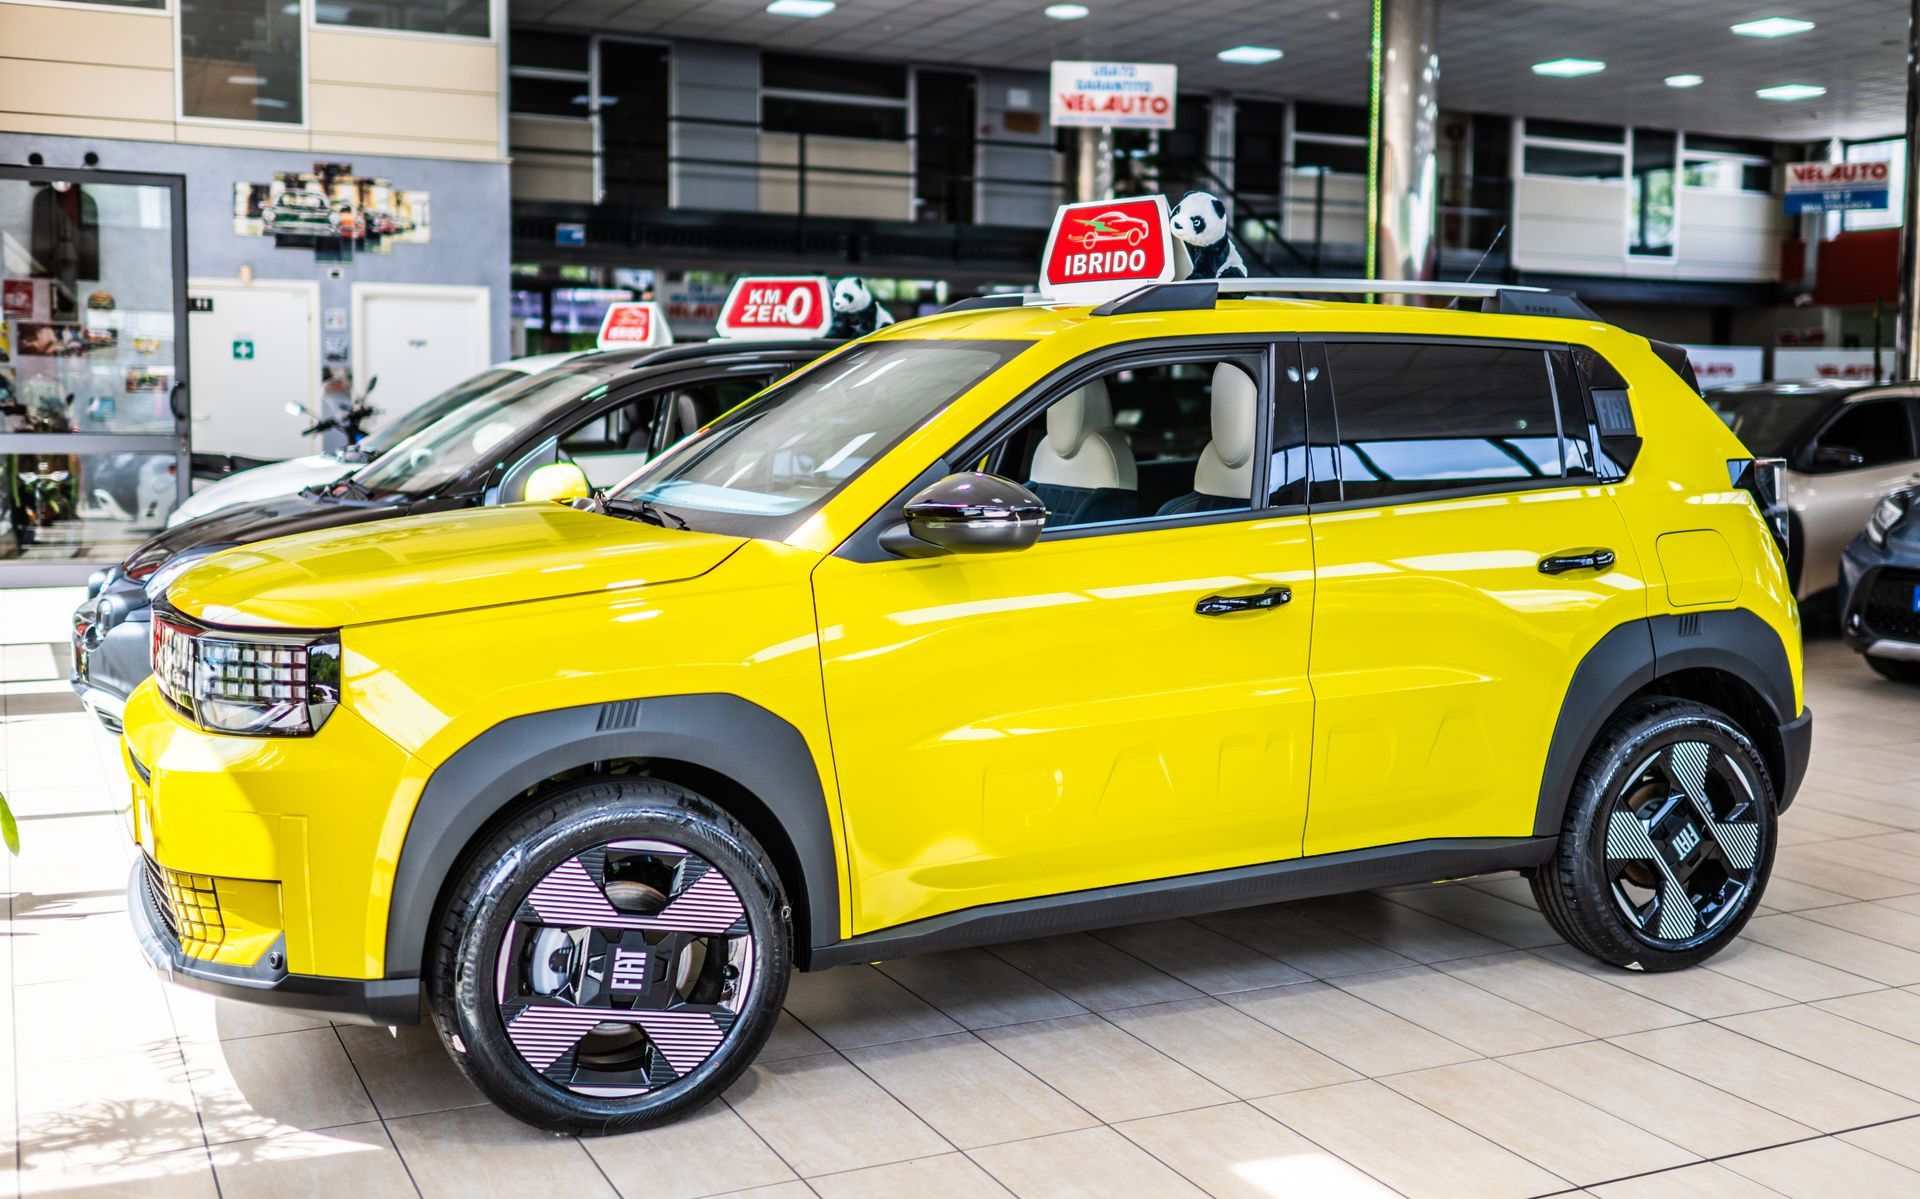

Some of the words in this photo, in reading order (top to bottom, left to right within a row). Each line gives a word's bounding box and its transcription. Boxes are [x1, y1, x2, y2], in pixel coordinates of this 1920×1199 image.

[1064, 249, 1146, 277] IBRIDO
[748, 289, 782, 305] KM
[1596, 395, 1632, 430] FIAT
[1672, 822, 1701, 861] FIAT
[611, 947, 647, 990] FIAT
